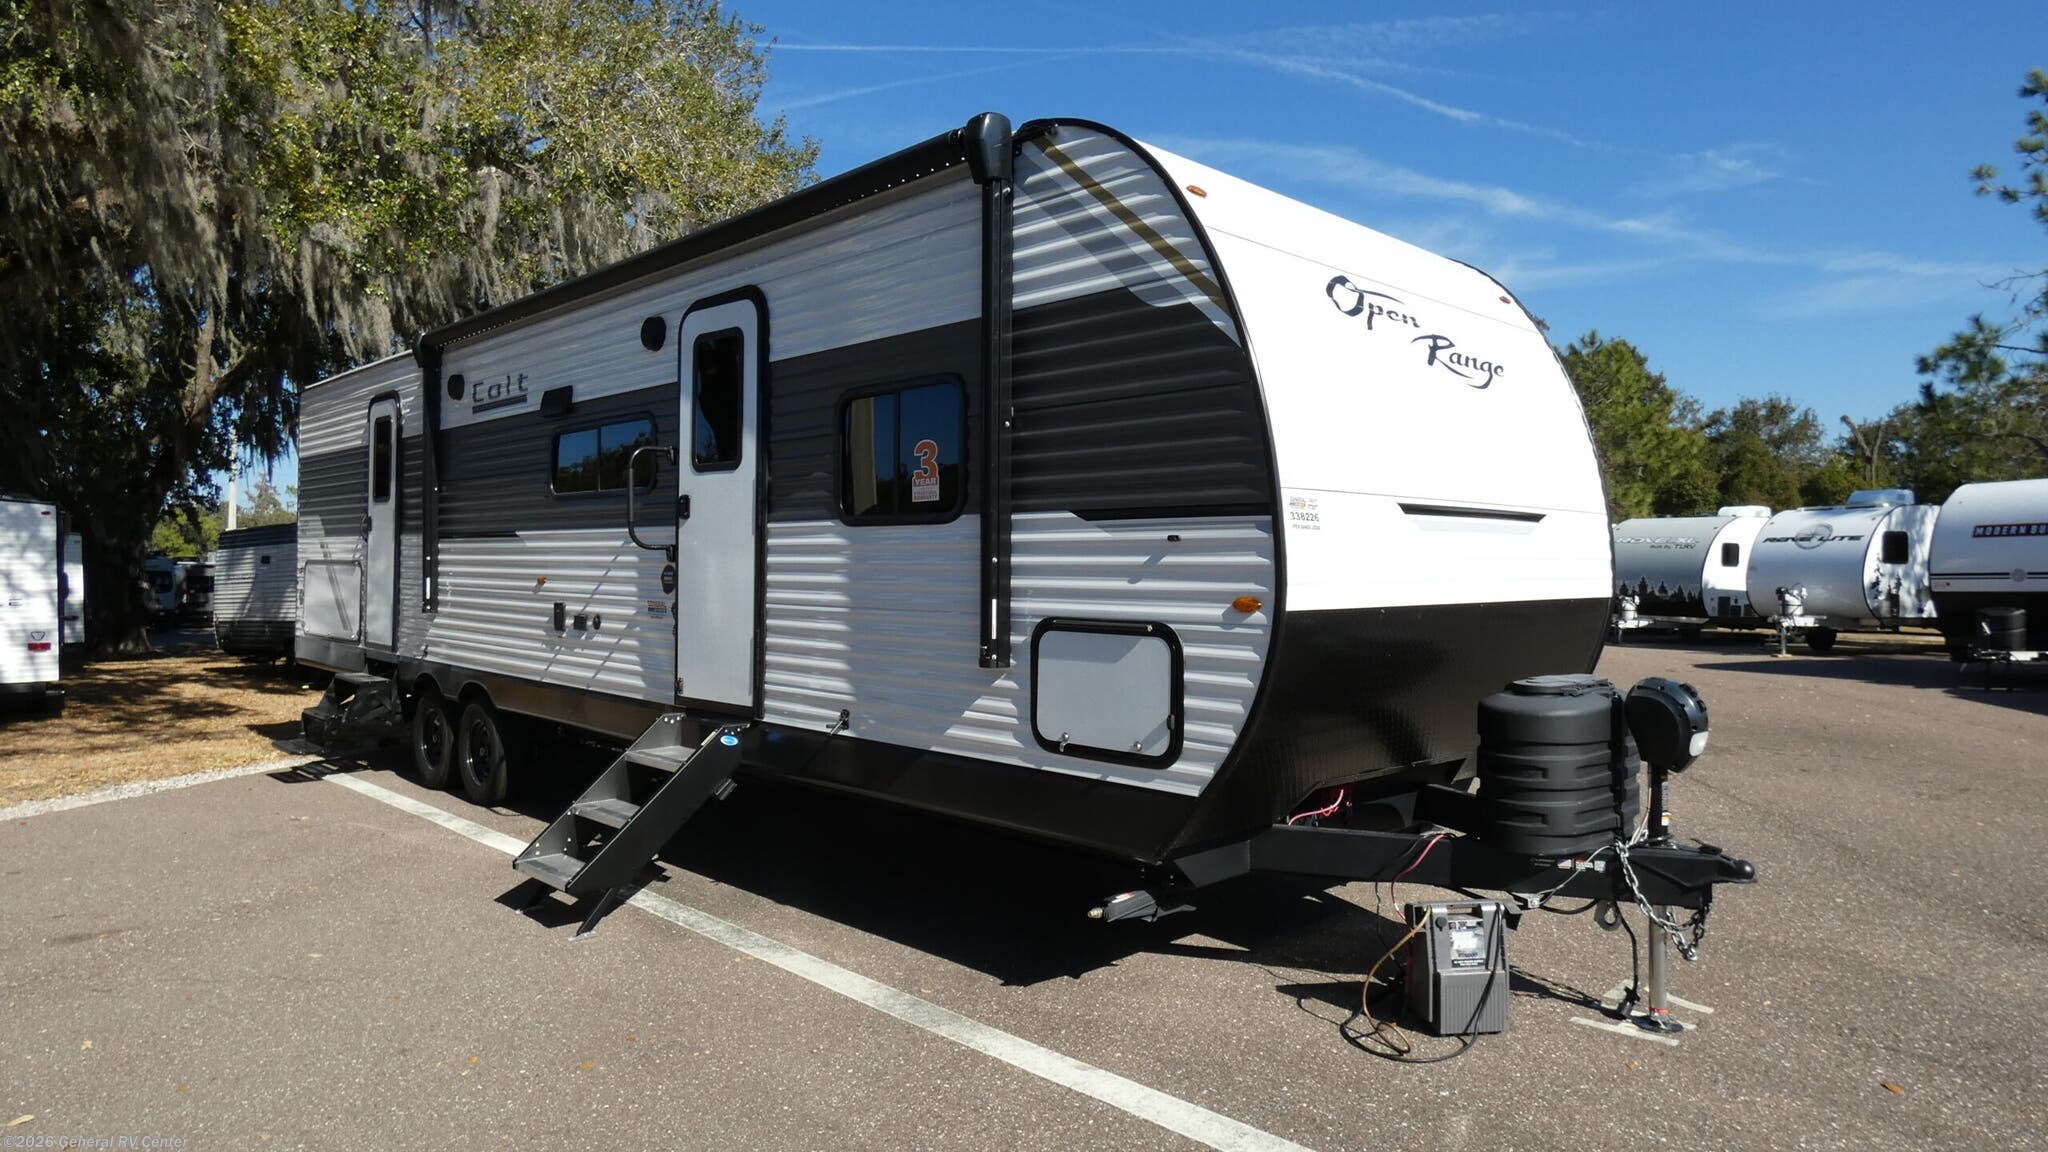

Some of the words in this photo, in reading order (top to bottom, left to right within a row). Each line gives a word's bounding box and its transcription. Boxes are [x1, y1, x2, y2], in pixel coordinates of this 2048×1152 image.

[1326, 275, 1420, 330] Open
[1411, 334, 1504, 389] Range
[472, 373, 528, 403] Colt
[914, 439, 938, 479] 3
[914, 477, 937, 486] YEAR
[1975, 525, 2026, 537] MODERN
